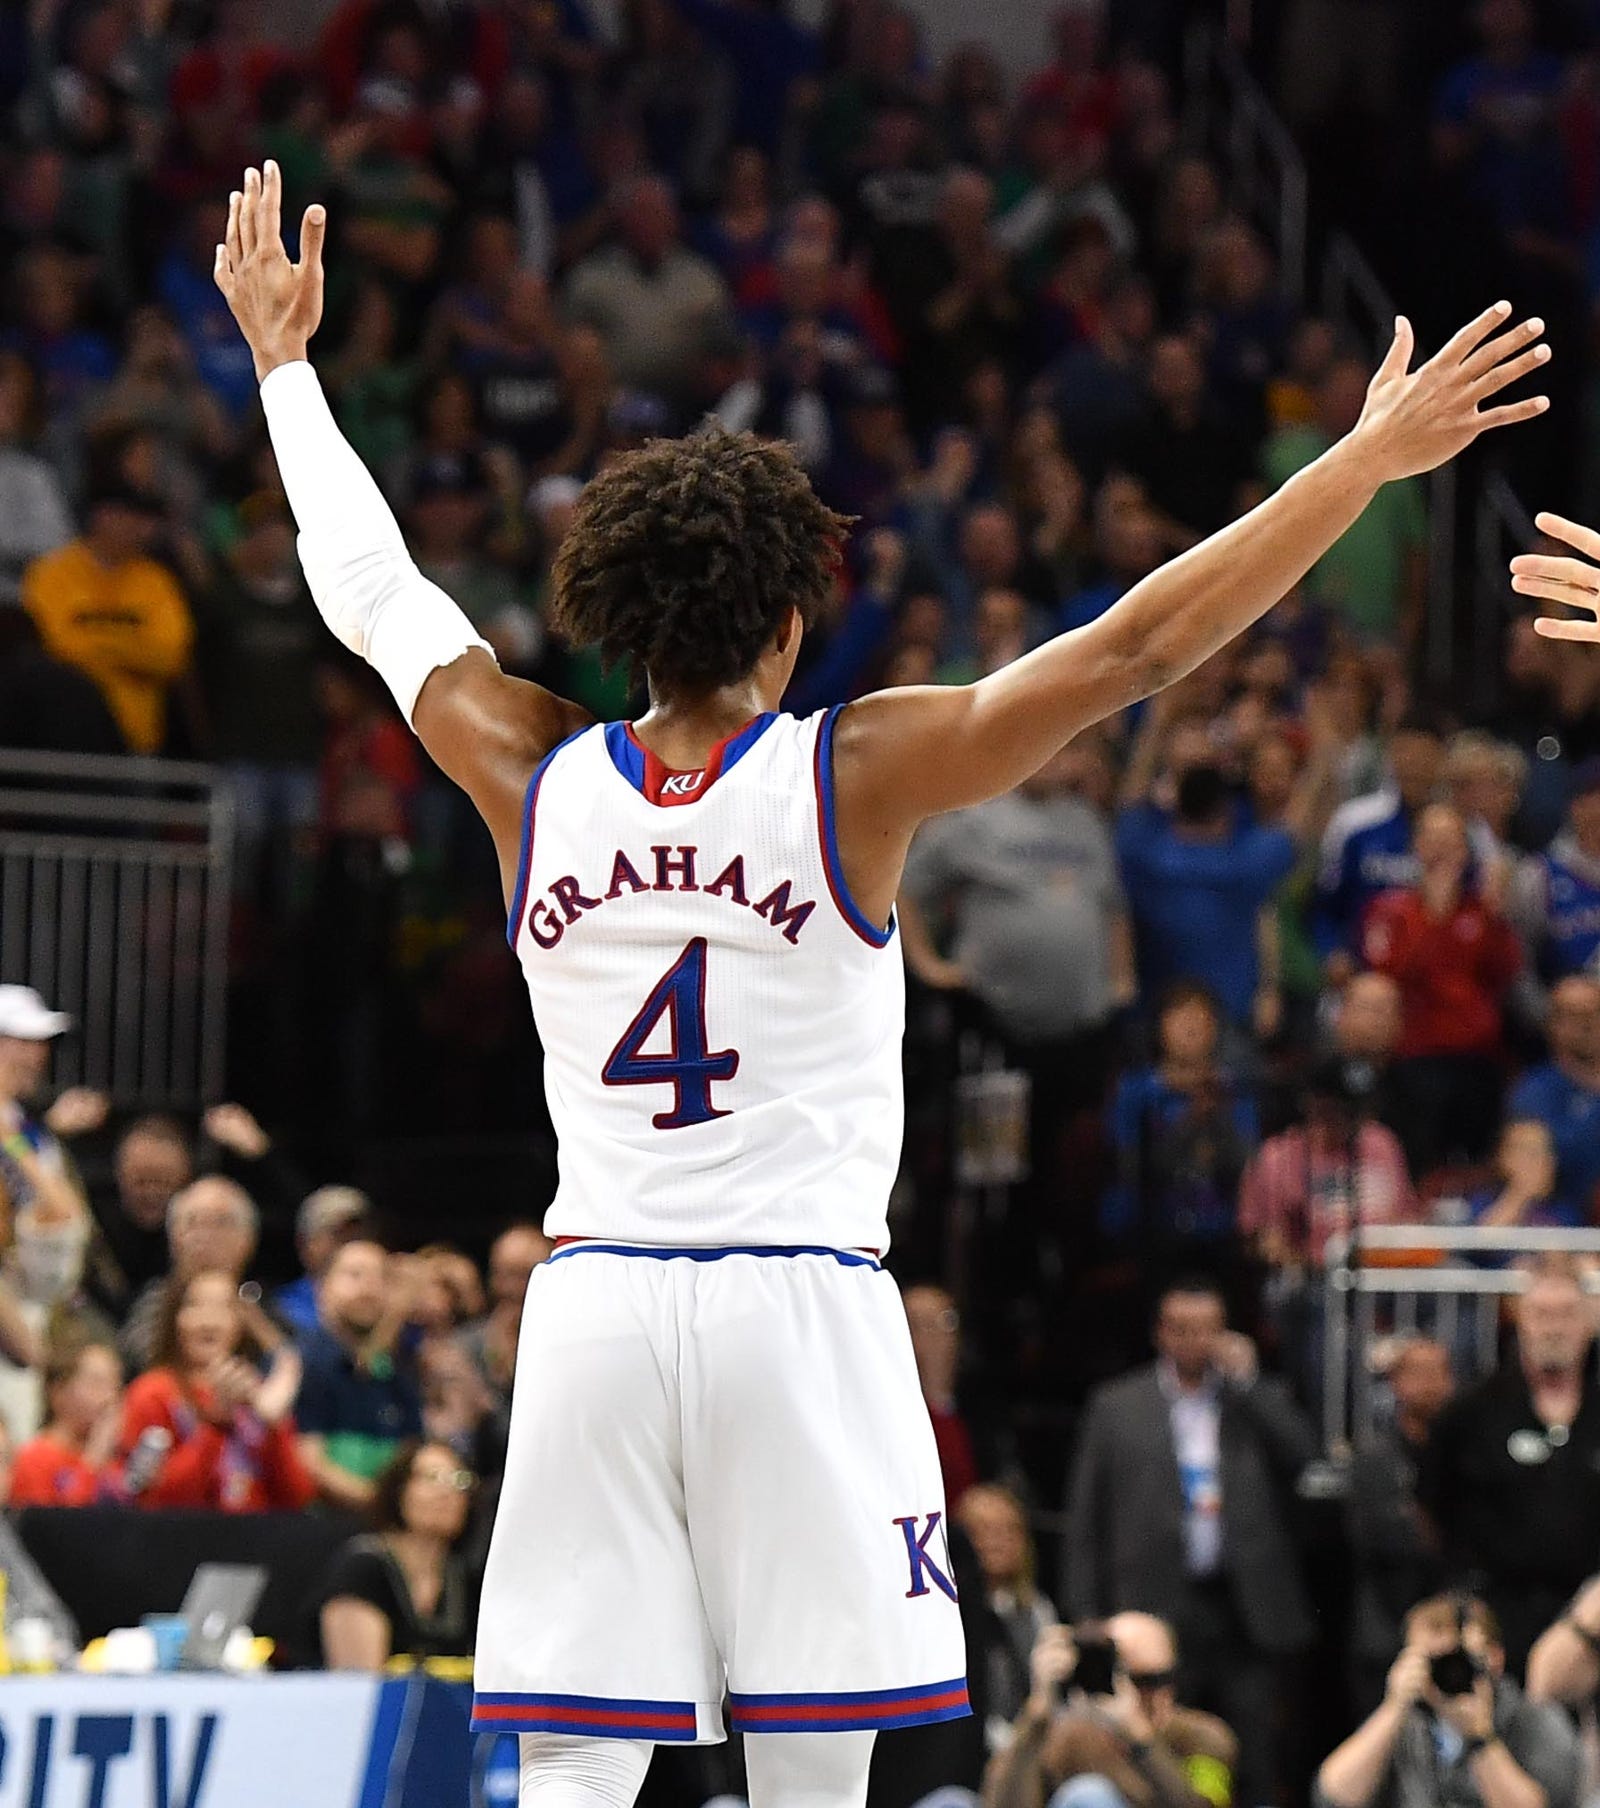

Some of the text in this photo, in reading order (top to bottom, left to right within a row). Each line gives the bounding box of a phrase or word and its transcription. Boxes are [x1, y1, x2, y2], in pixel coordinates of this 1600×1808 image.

[660, 771, 705, 795] KU
[528, 845, 816, 950] GRAHAM
[601, 936, 740, 1130] 4
[892, 1511, 959, 1604] K
